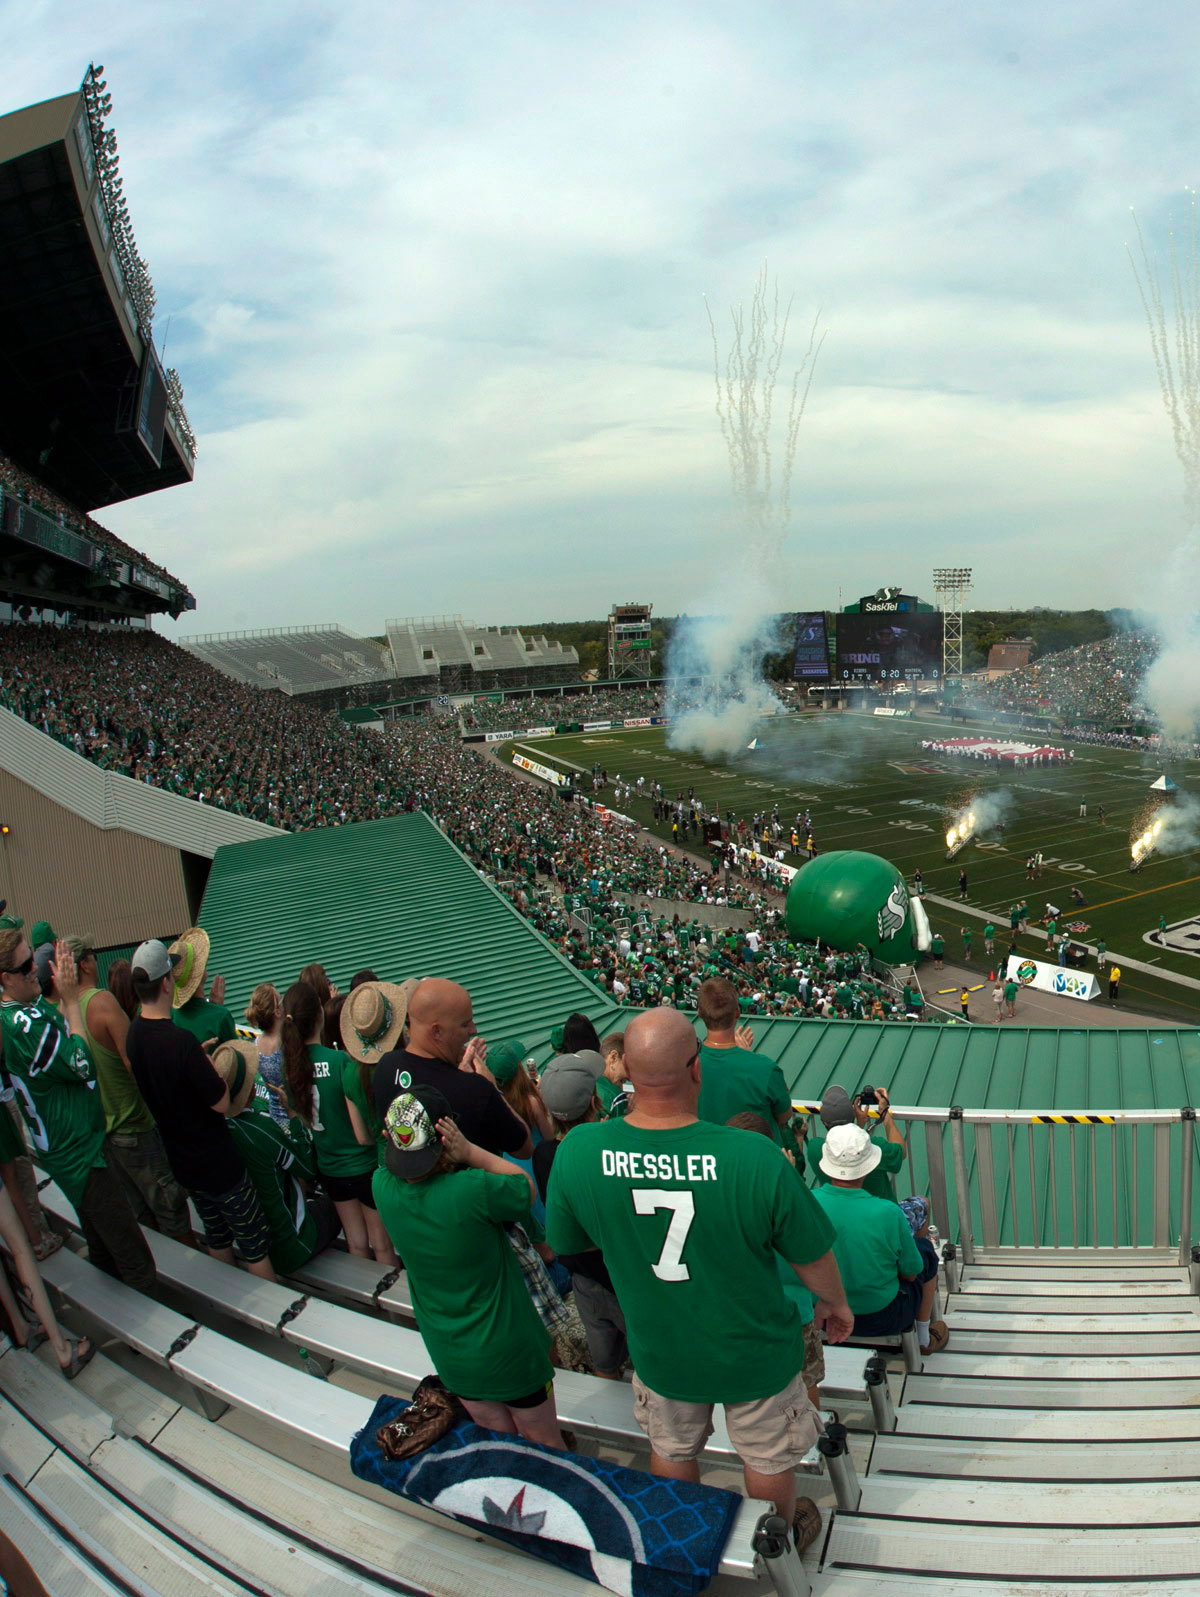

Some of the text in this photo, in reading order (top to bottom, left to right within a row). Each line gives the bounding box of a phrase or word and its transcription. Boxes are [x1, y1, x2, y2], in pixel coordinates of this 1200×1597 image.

[865, 602, 898, 611] SaskTel
[438, 695, 448, 705] 20
[624, 719, 651, 727] NISSAN
[495, 732, 513, 740] YARA
[602, 1149, 718, 1182] DRESSLER
[630, 1188, 696, 1282] 7
